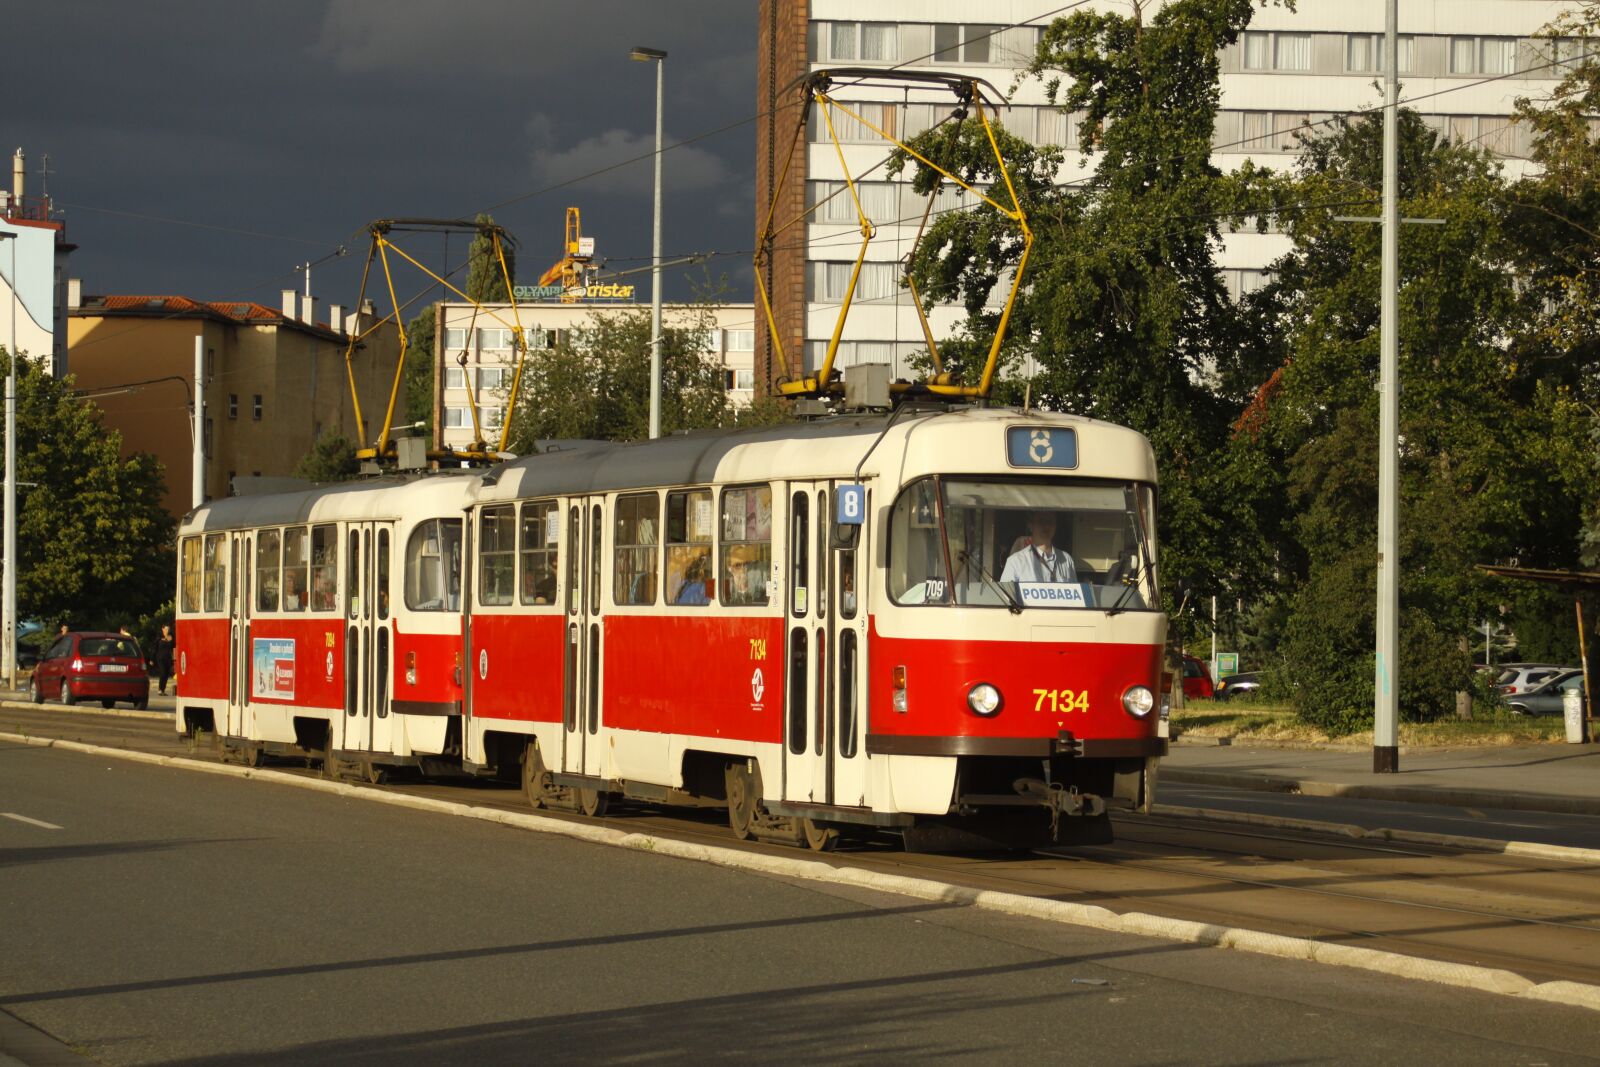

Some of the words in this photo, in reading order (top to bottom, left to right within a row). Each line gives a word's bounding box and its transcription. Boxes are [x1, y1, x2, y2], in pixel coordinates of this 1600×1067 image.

[1029, 429, 1053, 463] 8
[844, 490, 858, 517] 8
[926, 579, 944, 597] 709
[1022, 588, 1082, 601] PODBABA
[749, 638, 767, 661] 7134
[1032, 688, 1090, 713] 7134
